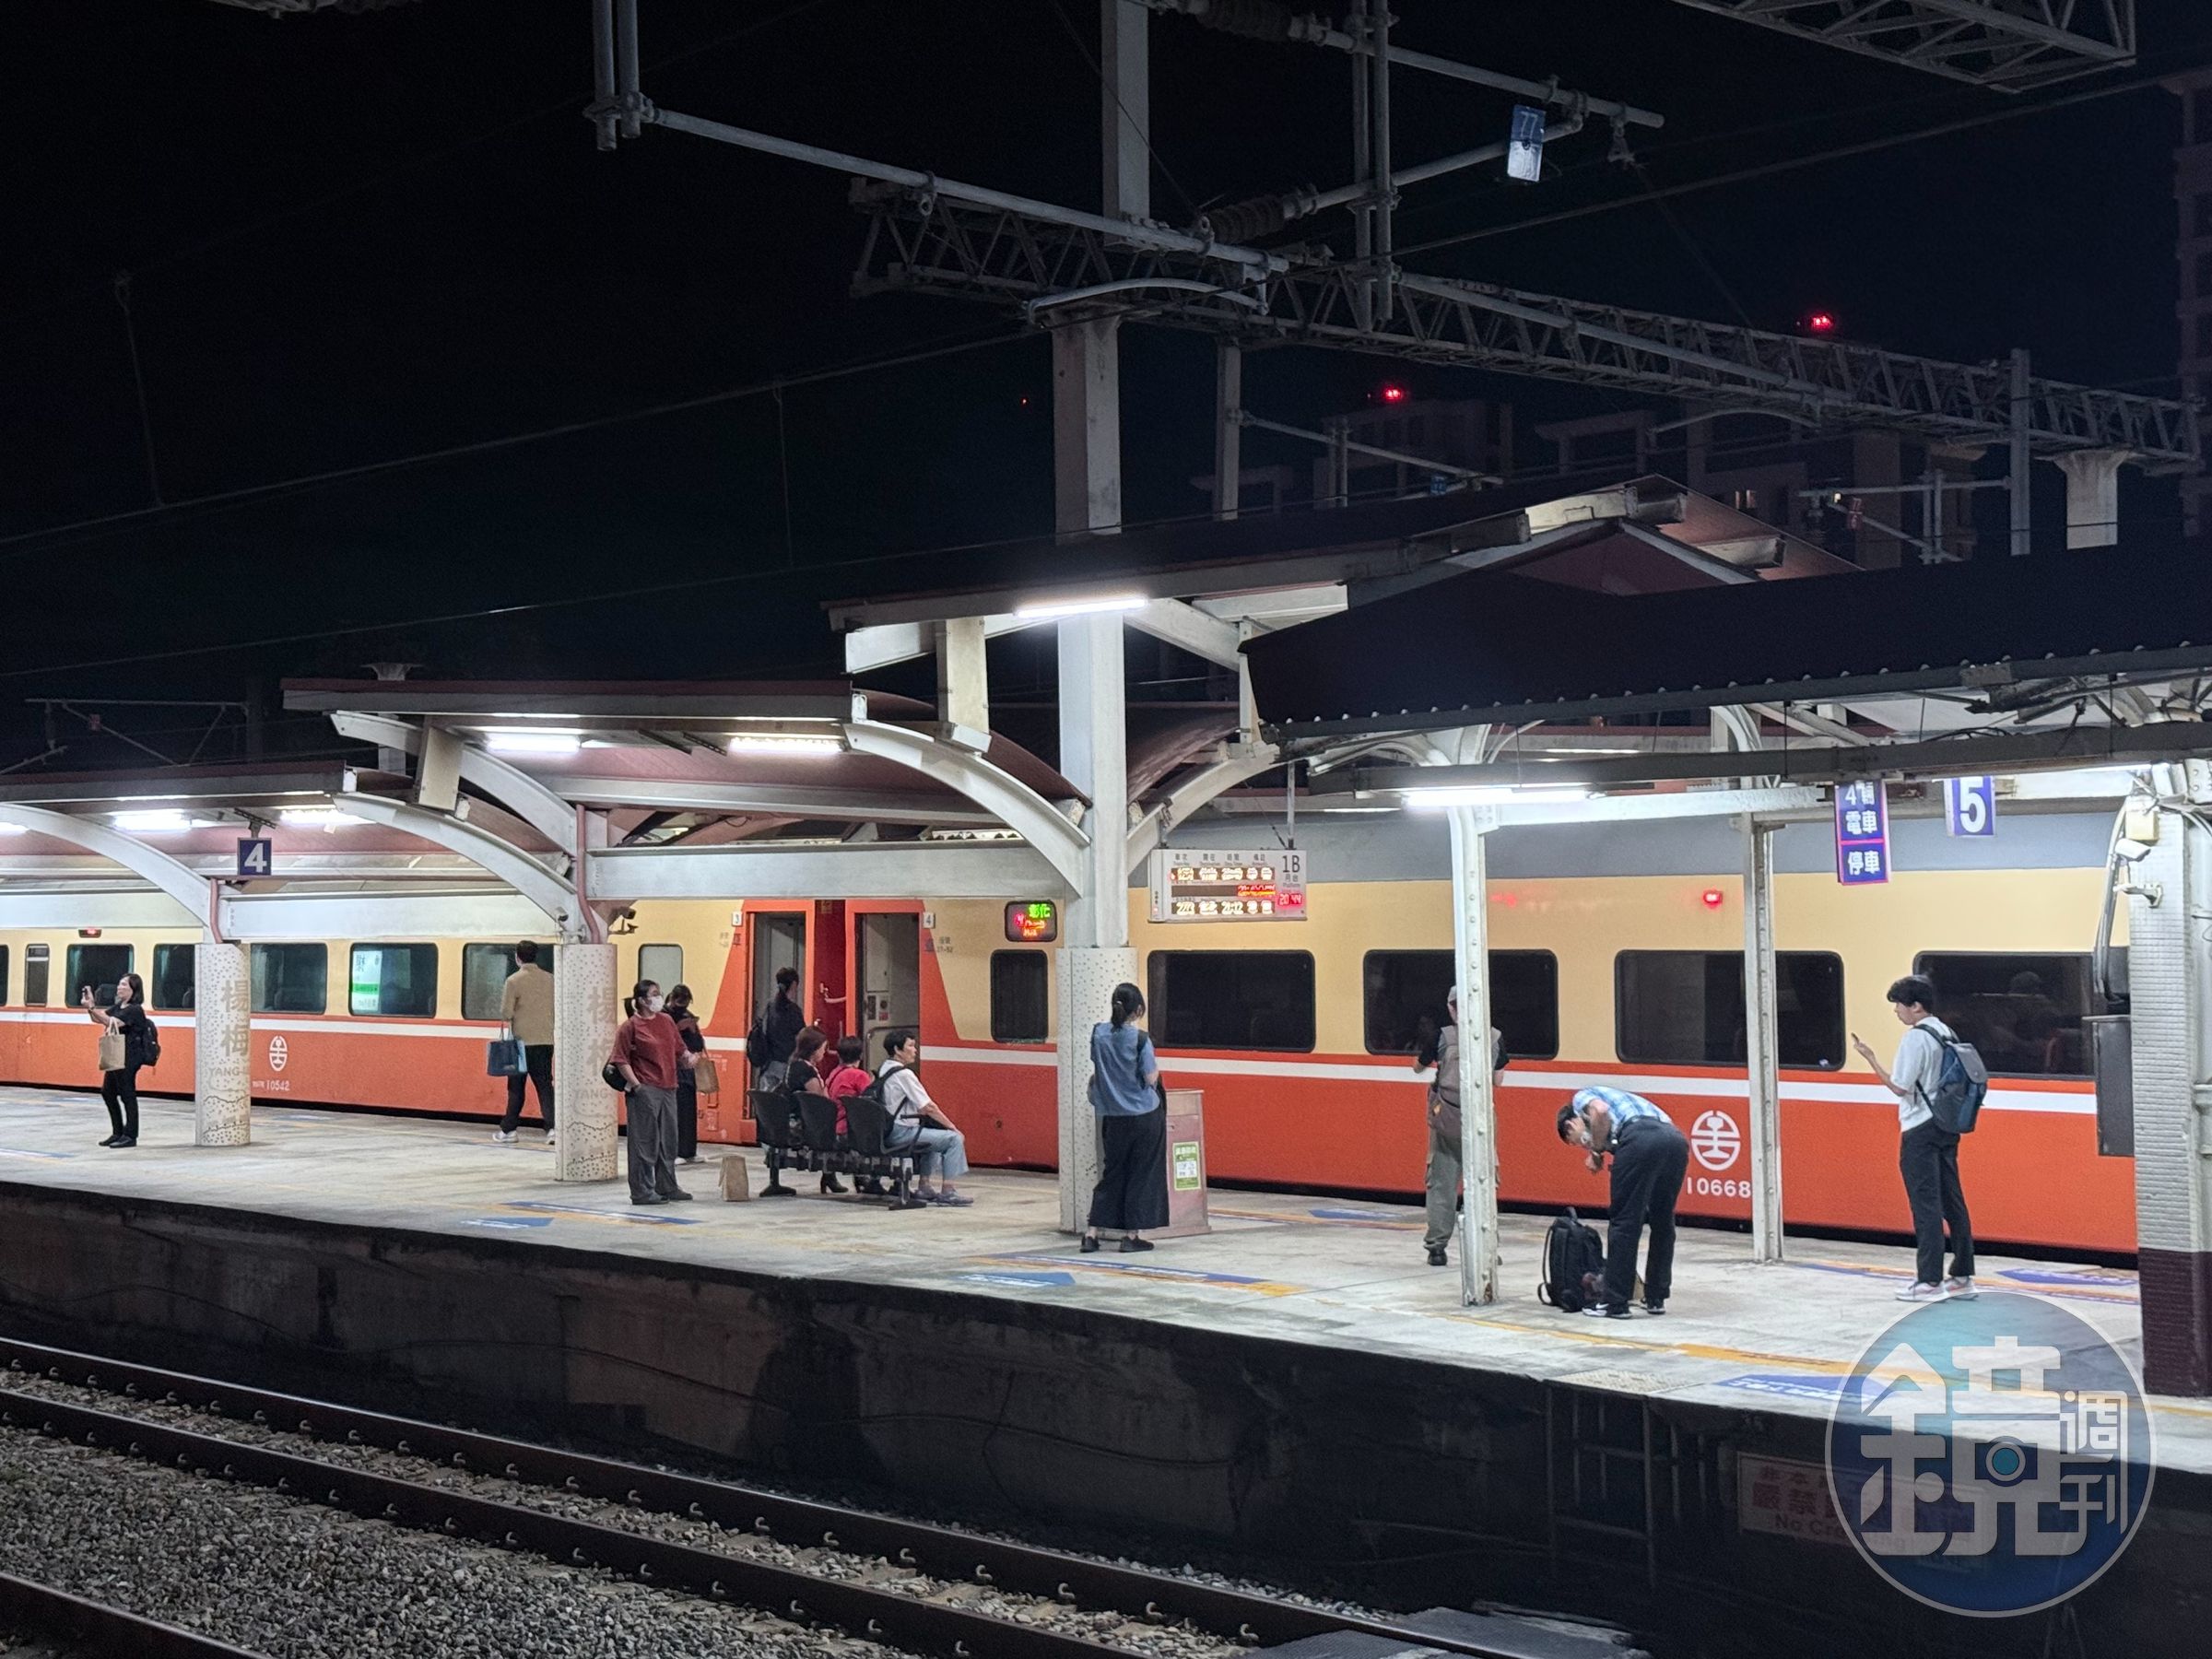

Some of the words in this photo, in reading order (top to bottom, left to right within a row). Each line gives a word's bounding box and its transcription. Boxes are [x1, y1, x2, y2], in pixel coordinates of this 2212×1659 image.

[1959, 776, 1986, 833] 5
[1845, 810, 1877, 835] 電車
[244, 842, 267, 873] 4
[1282, 855, 1300, 873] 1B
[1848, 850, 1880, 876] 停車
[221, 980, 249, 1057] 楊梅
[1687, 1177, 1751, 1198] 10668
